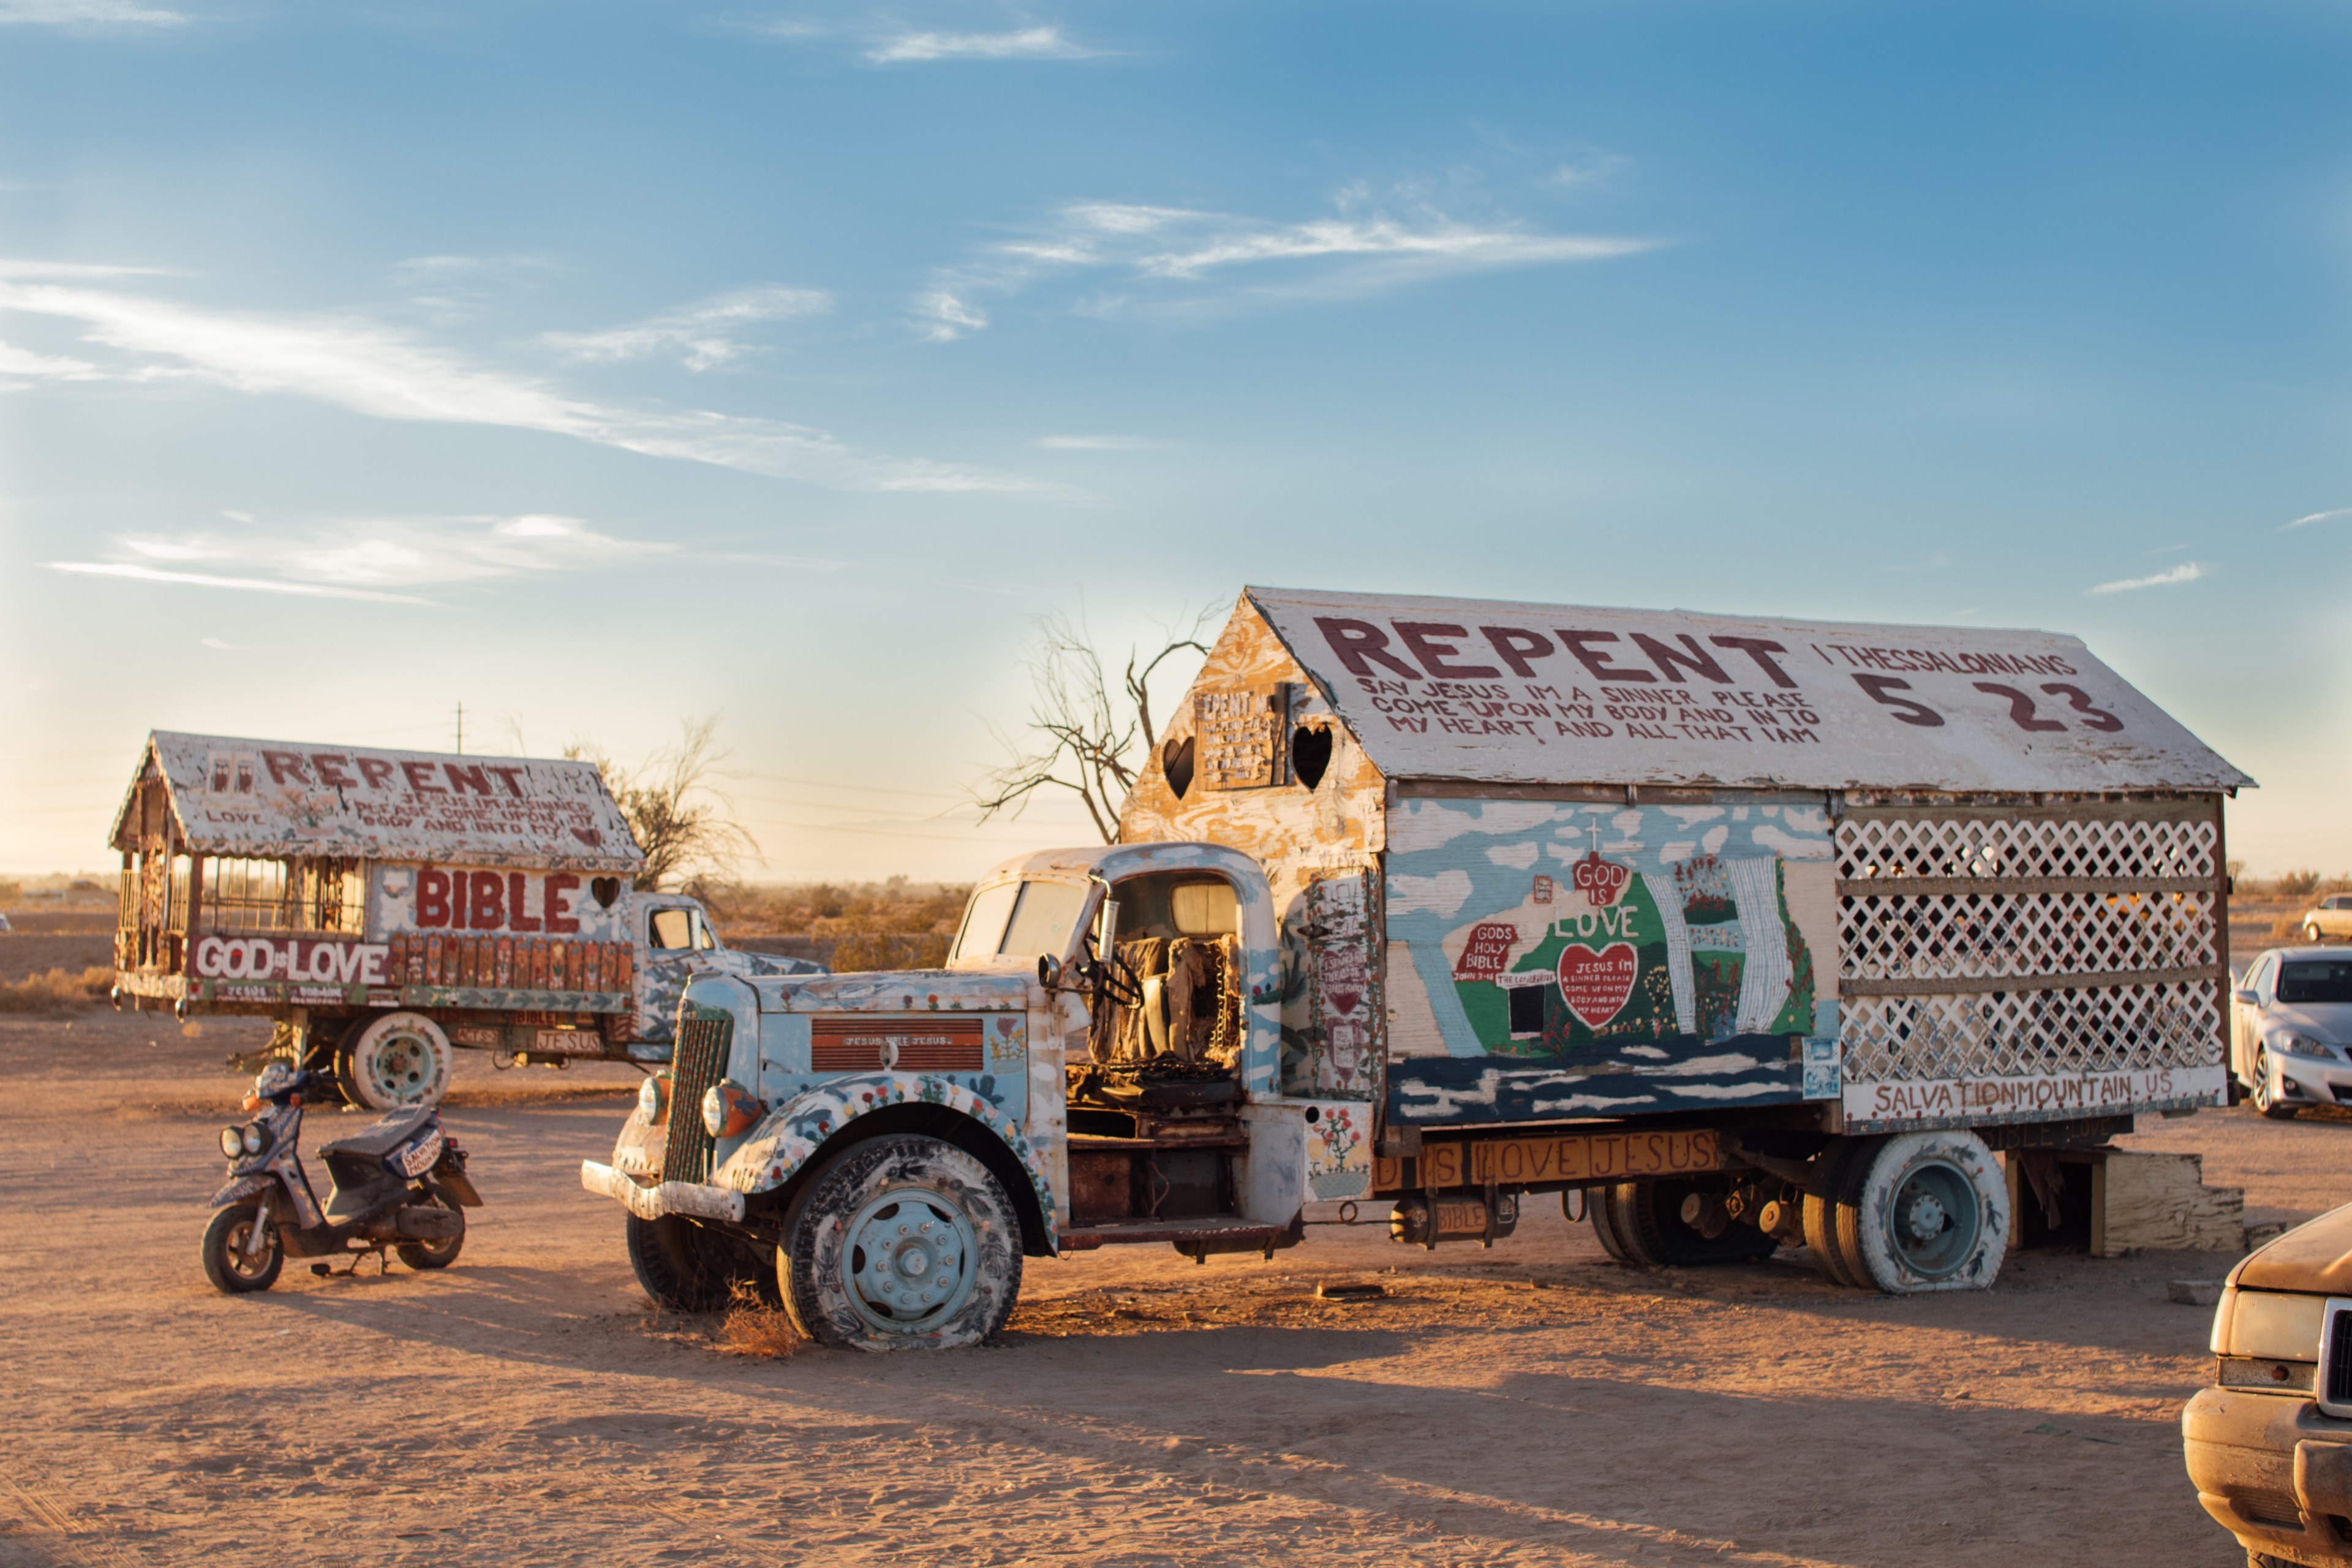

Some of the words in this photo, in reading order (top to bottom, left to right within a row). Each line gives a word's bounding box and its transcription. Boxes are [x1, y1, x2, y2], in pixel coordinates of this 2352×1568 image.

[1312, 616, 1798, 688] REPENT
[1827, 644, 2078, 675] THESSALONIANS
[1356, 677, 1409, 696] SAY
[1422, 681, 1510, 699] JESUS
[1572, 685, 1593, 701] A
[1600, 686, 1699, 706] SINNER
[1711, 691, 1814, 708] PLEASE
[1850, 673, 1945, 726] 5
[1972, 682, 2125, 732] 23
[1371, 696, 1459, 717] COME
[1460, 701, 1552, 719] UPON
[1555, 703, 1594, 719] MY
[1603, 704, 1667, 722] BODY
[1678, 707, 1735, 723] AND
[1386, 715, 1428, 733] MY
[1437, 717, 1539, 736] HEART
[1555, 721, 1614, 738] AND
[1625, 722, 1677, 740] ALL
[1673, 724, 1754, 742] THAT
[260, 749, 526, 798] REPENT
[355, 799, 431, 818] PLEASE
[440, 807, 486, 820] COME
[501, 810, 555, 823] UPON
[568, 813, 592, 826] MY
[401, 793, 469, 807] JESUS
[526, 799, 590, 813] SINNER
[205, 809, 266, 825] LOVE
[363, 815, 413, 828] BODY
[423, 819, 467, 832] AND
[475, 823, 523, 834] INTO
[530, 823, 560, 840] MY
[1576, 862, 1624, 888] GOD
[415, 869, 581, 934] BIBLE
[1591, 888, 1607, 905] IS
[1477, 926, 1512, 940] GODS
[1553, 905, 1640, 938] LOVE
[196, 936, 274, 980] GOD
[275, 951, 287, 968] IS
[287, 940, 389, 984] LOVE
[1474, 941, 1506, 954] HOLY
[1466, 953, 1502, 969] BIBLE
[1575, 961, 1613, 974] JESUS
[1453, 971, 1476, 981] JOHN
[538, 1030, 600, 1052] JESUS
[845, 1037, 882, 1046] JESUS
[1475, 1139, 1578, 1182] LOVE
[1594, 1131, 1714, 1175] JESUS
[1437, 1205, 1485, 1230] BIBLE
